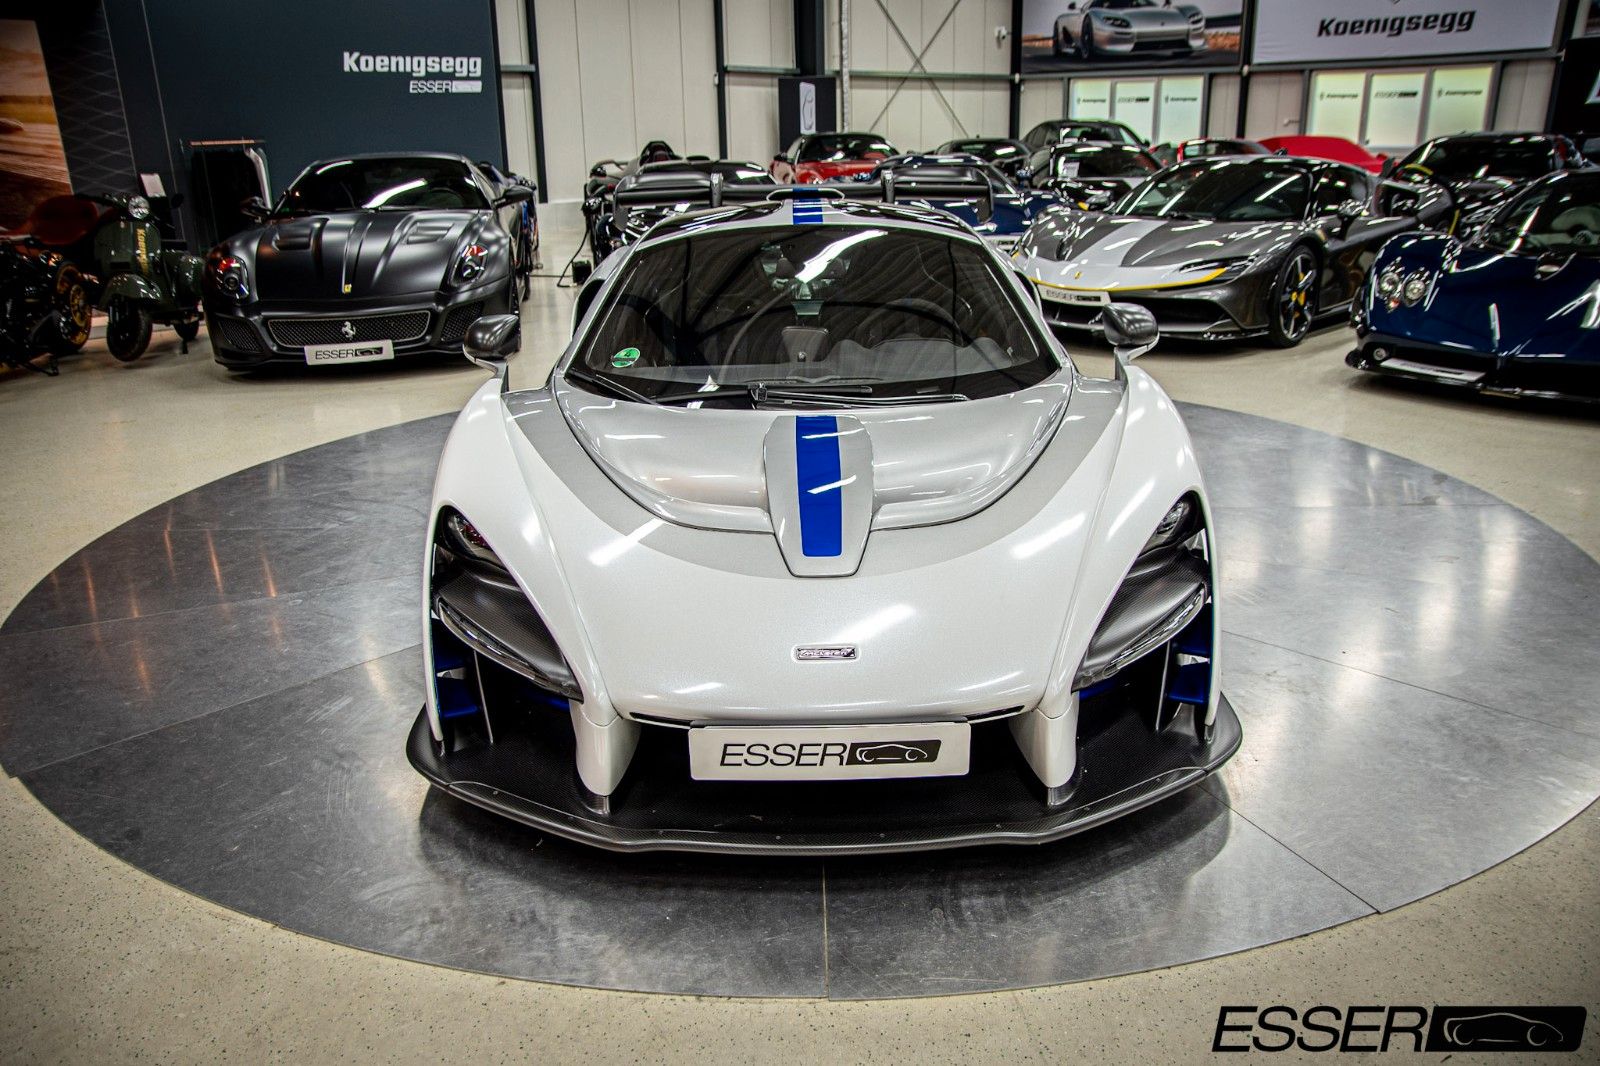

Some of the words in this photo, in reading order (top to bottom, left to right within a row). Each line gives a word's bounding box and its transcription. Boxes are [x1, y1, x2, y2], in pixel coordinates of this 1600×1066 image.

[1316, 10, 1477, 37] Koenigsegg
[343, 51, 482, 77] Koenigsegg
[409, 80, 451, 93] ESSER
[315, 348, 355, 360] ESSER
[719, 742, 848, 767] ESSER
